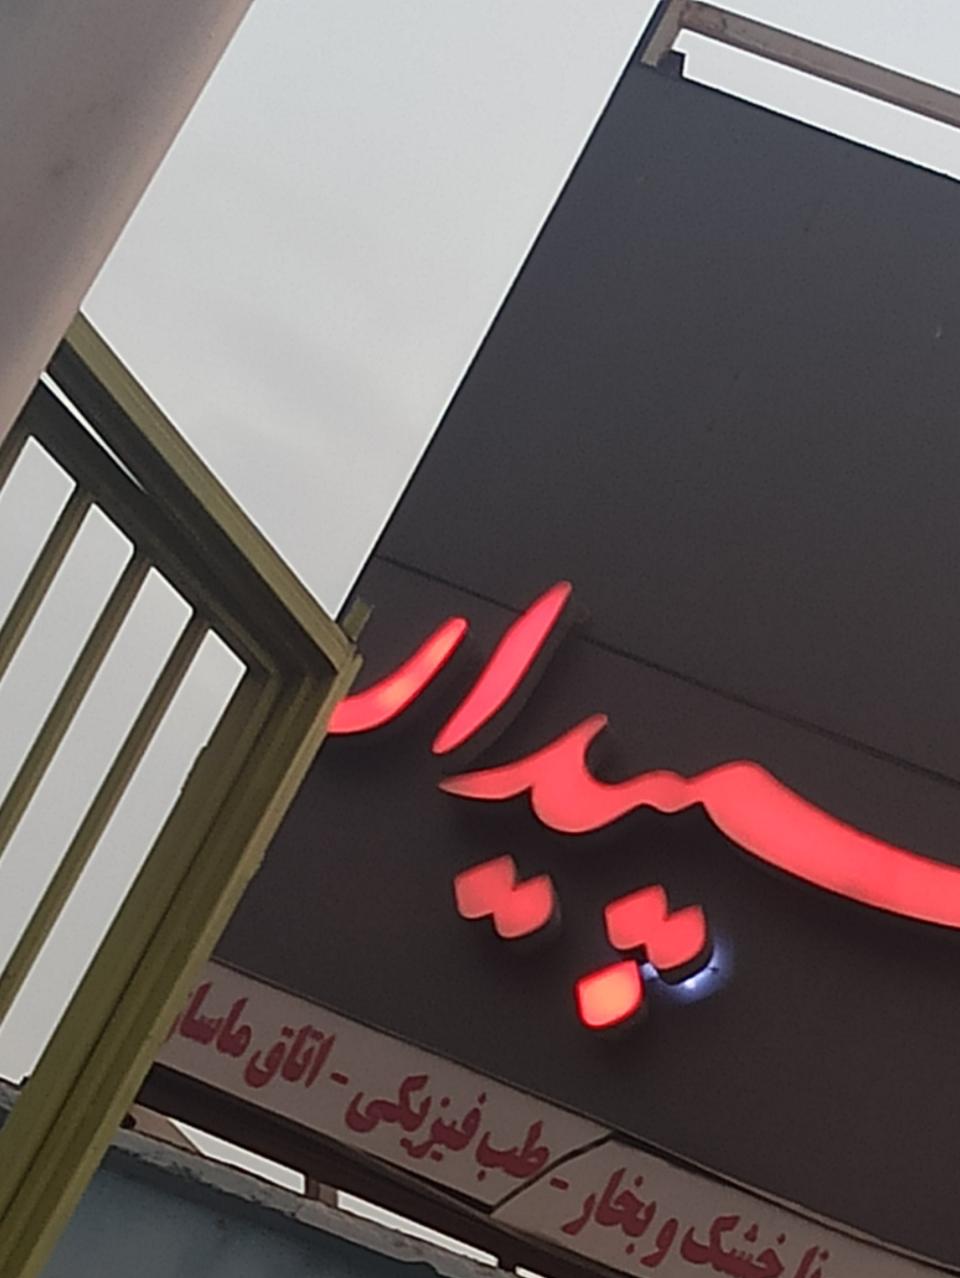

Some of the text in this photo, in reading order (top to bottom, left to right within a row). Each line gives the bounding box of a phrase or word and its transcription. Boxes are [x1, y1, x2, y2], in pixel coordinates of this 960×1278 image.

[163, 981, 253, 1058] ماسا
[244, 1025, 337, 1089] اتاق
[345, 1074, 486, 1162] فیزیکی
[474, 1121, 550, 1181] طب
[563, 1168, 656, 1254] بخار
